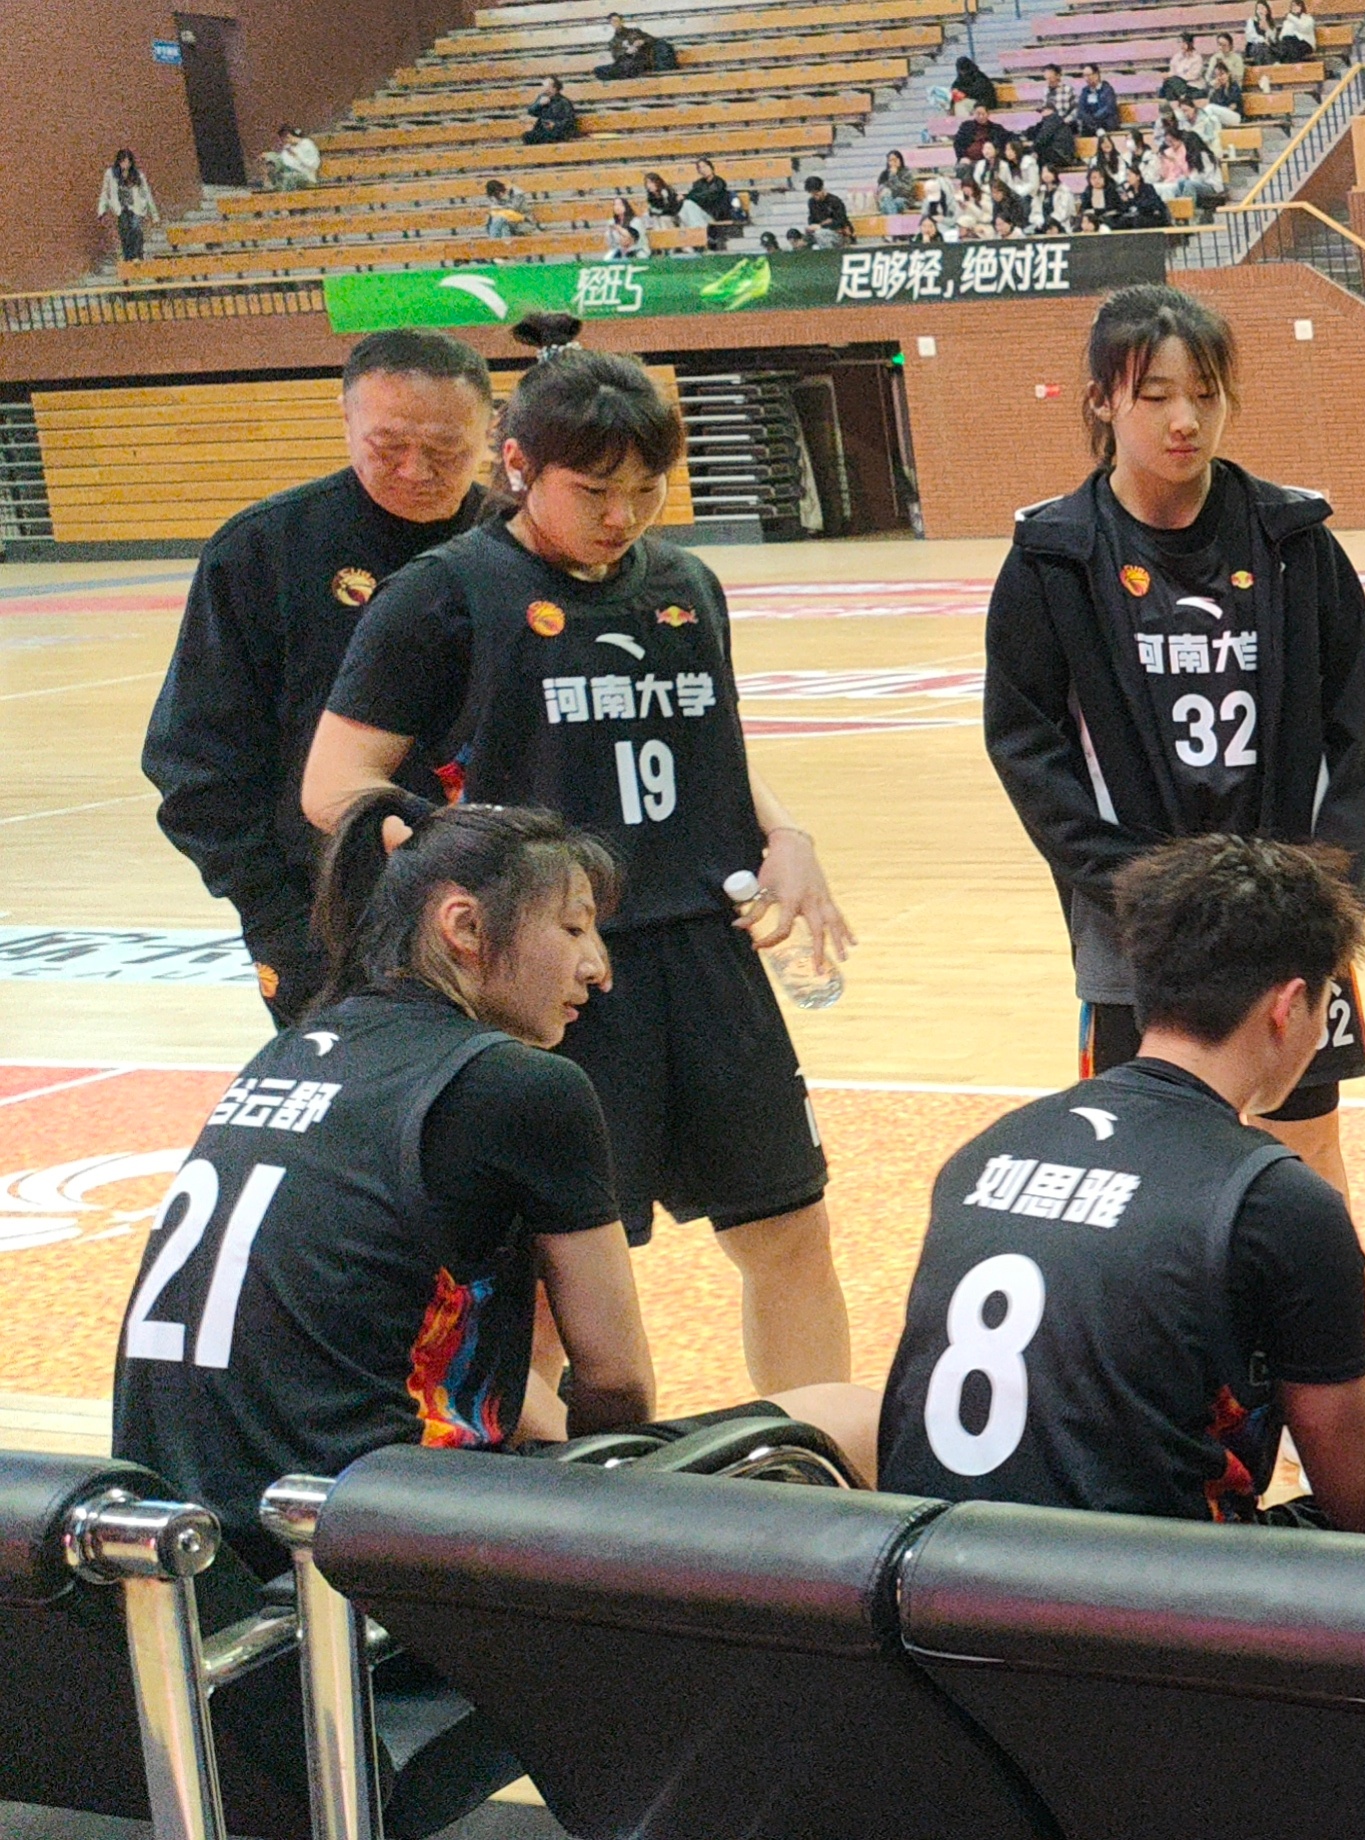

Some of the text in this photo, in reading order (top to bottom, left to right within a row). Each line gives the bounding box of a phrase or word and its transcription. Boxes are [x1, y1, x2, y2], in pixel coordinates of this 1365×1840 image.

[543, 673, 715, 723] 河南大学
[1173, 691, 1257, 767] 32
[615, 740, 676, 825] 19
[963, 1154, 1141, 1228] 刘思雅
[126, 1159, 286, 1368] 21
[925, 1253, 1045, 1476] 8
